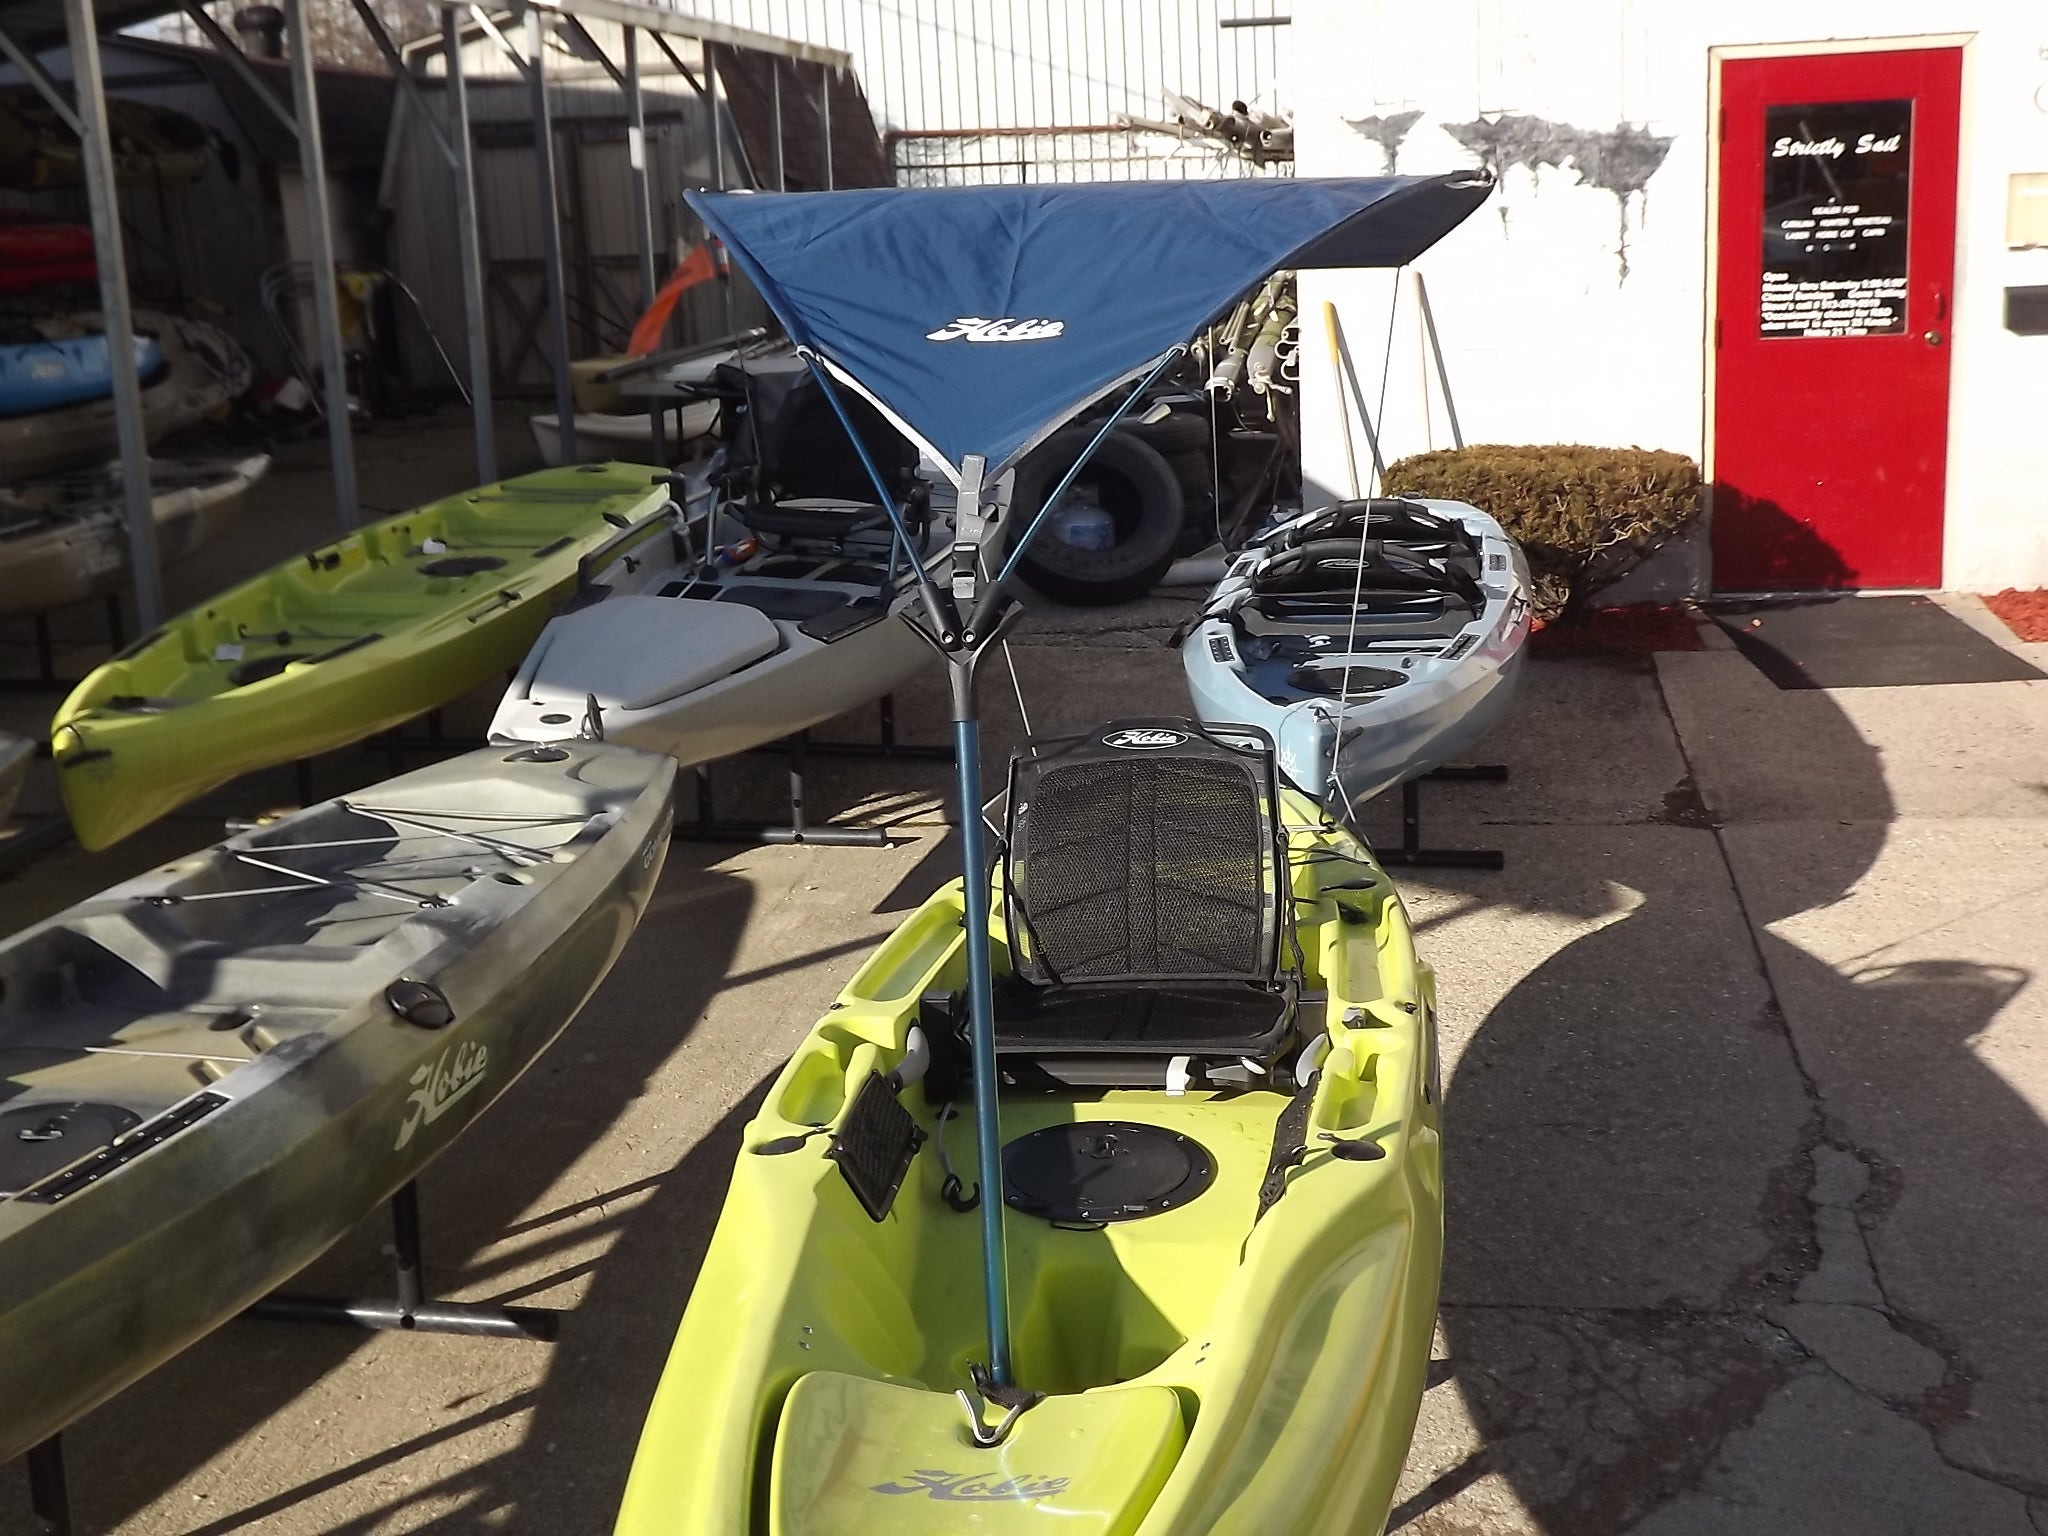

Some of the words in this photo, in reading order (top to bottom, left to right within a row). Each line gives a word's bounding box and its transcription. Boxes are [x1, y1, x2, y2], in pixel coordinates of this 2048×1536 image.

[1772, 137, 1845, 159] Strictly
[1855, 134, 1901, 154] Sail
[925, 317, 1065, 342] Hobie
[1113, 730, 1177, 745] Hobie
[394, 1040, 487, 1151] Hobie
[869, 1469, 1071, 1501] Hobie
